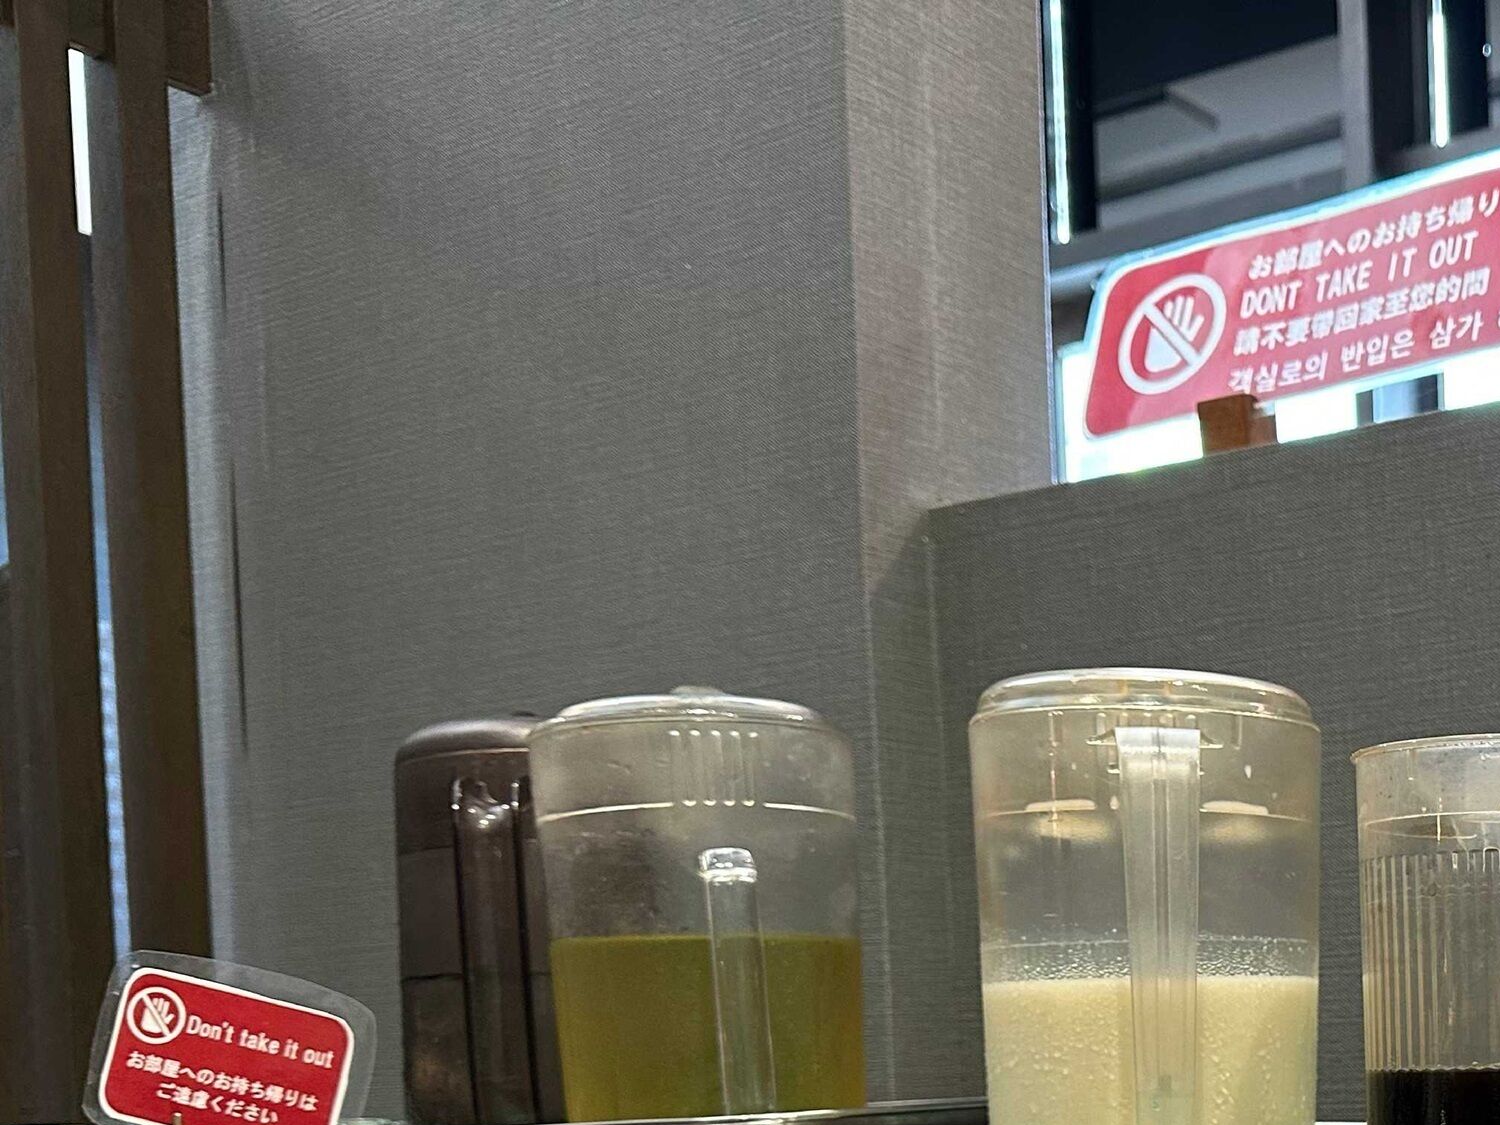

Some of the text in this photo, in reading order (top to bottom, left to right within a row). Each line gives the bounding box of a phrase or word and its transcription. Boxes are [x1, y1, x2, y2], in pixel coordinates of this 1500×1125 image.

[1240, 230, 1479, 319] DONT TAKE IT OUT
[1228, 352, 1329, 394] 객실로의
[1341, 329, 1415, 373] 반입은
[1429, 310, 1484, 350] 삼가
[185, 1014, 334, 1070] Don't take it out
[126, 1051, 319, 1112] お部屋へのお持ち帰りは
[155, 1082, 279, 1124] ご遠慮ください
